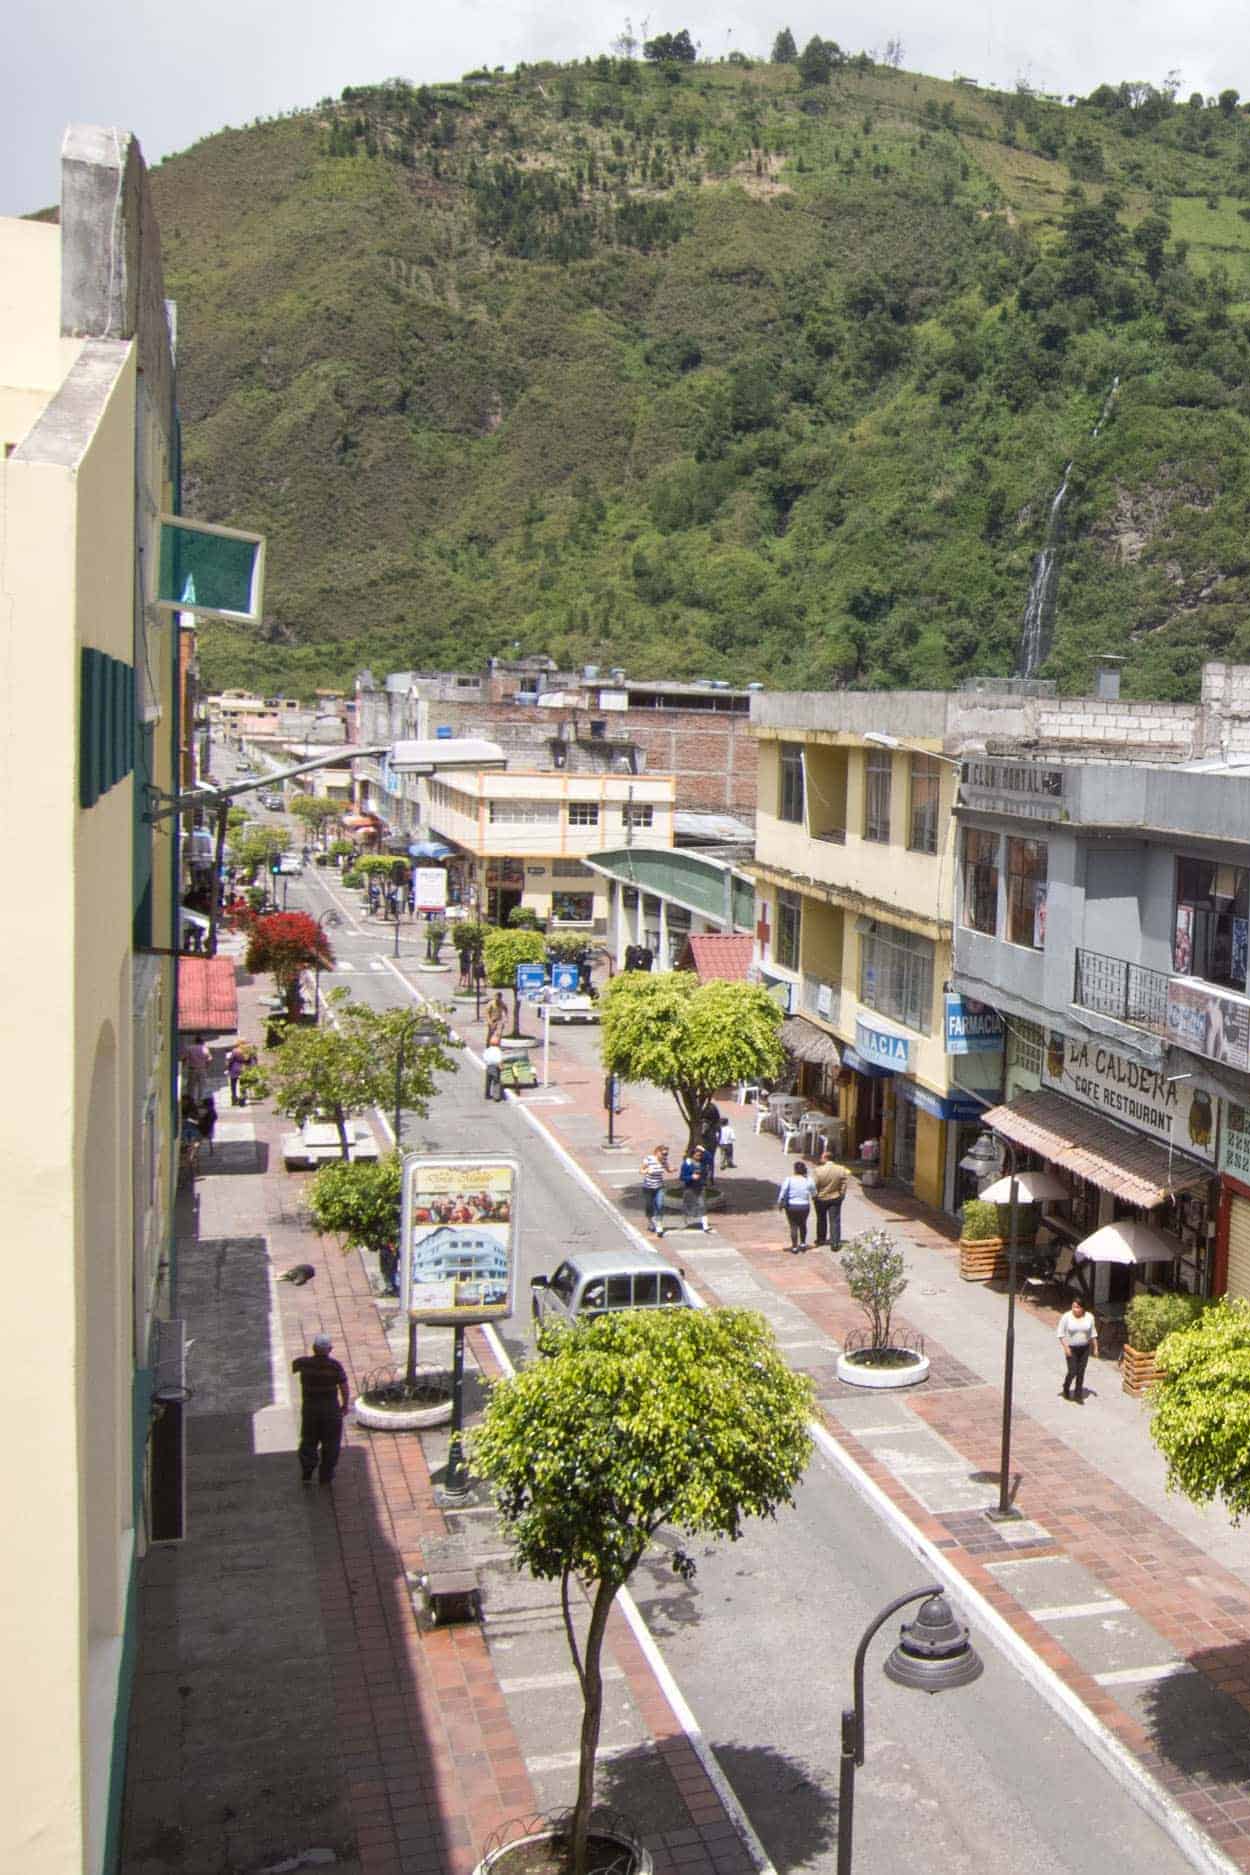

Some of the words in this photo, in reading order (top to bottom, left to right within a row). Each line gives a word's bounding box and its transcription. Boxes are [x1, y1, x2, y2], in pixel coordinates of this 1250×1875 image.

[949, 1015, 1002, 1036] FARMACIA
[1070, 1041, 1088, 1068] LA
[1095, 1049, 1178, 1106] CALDERA
[1074, 1075, 1100, 1101] CAFE
[1103, 1088, 1173, 1132] RESTAURANT
